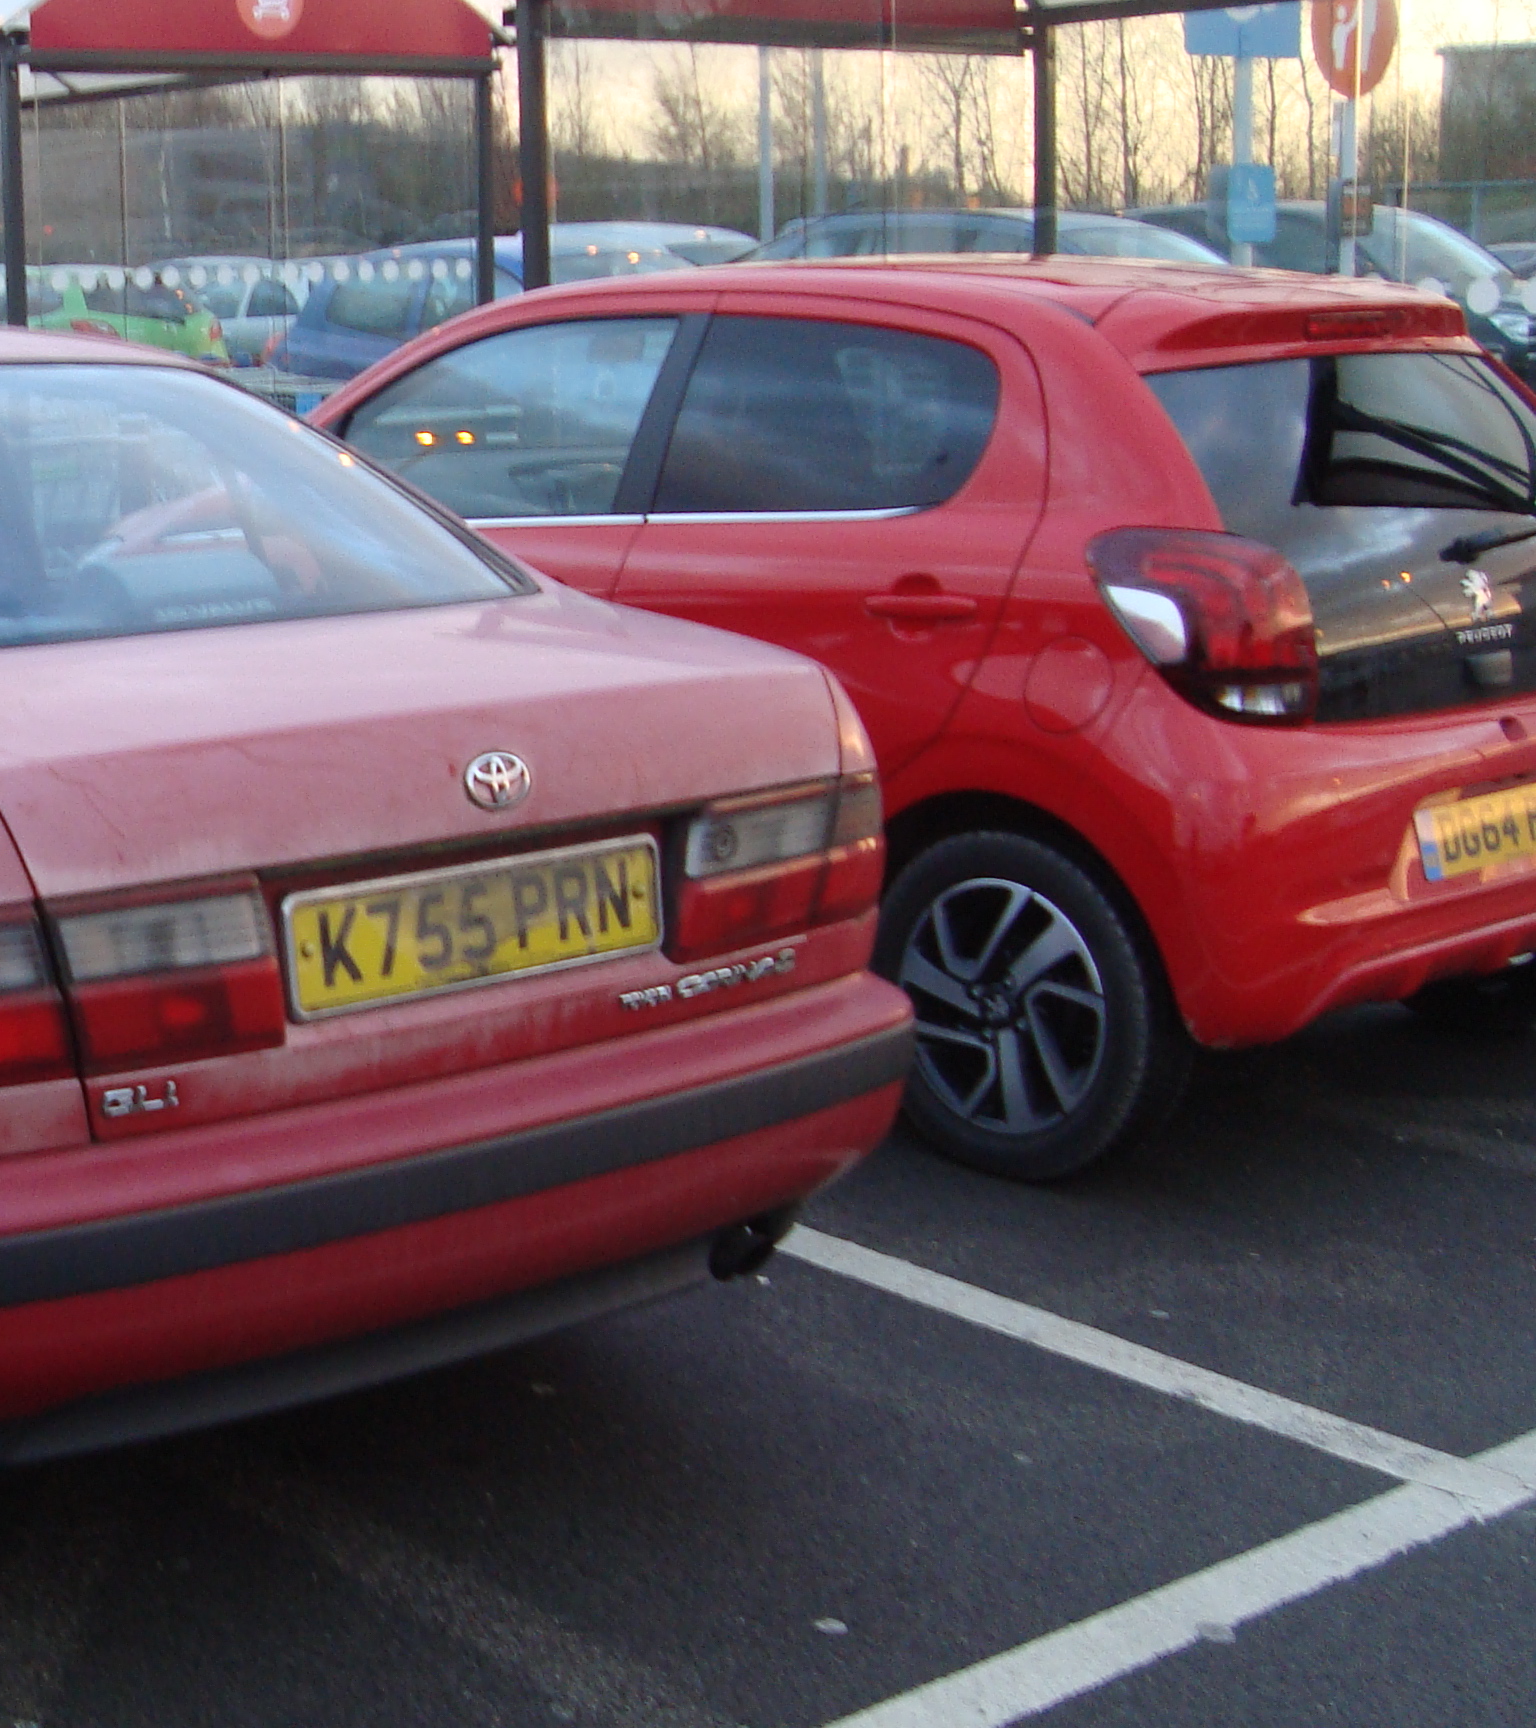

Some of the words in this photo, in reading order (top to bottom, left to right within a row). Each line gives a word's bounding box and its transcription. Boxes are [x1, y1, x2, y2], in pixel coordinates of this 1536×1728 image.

[1455, 622, 1513, 645] PEUGEOT
[1436, 797, 1520, 862] DG64
[316, 880, 498, 988] K755
[512, 857, 632, 949] PRN
